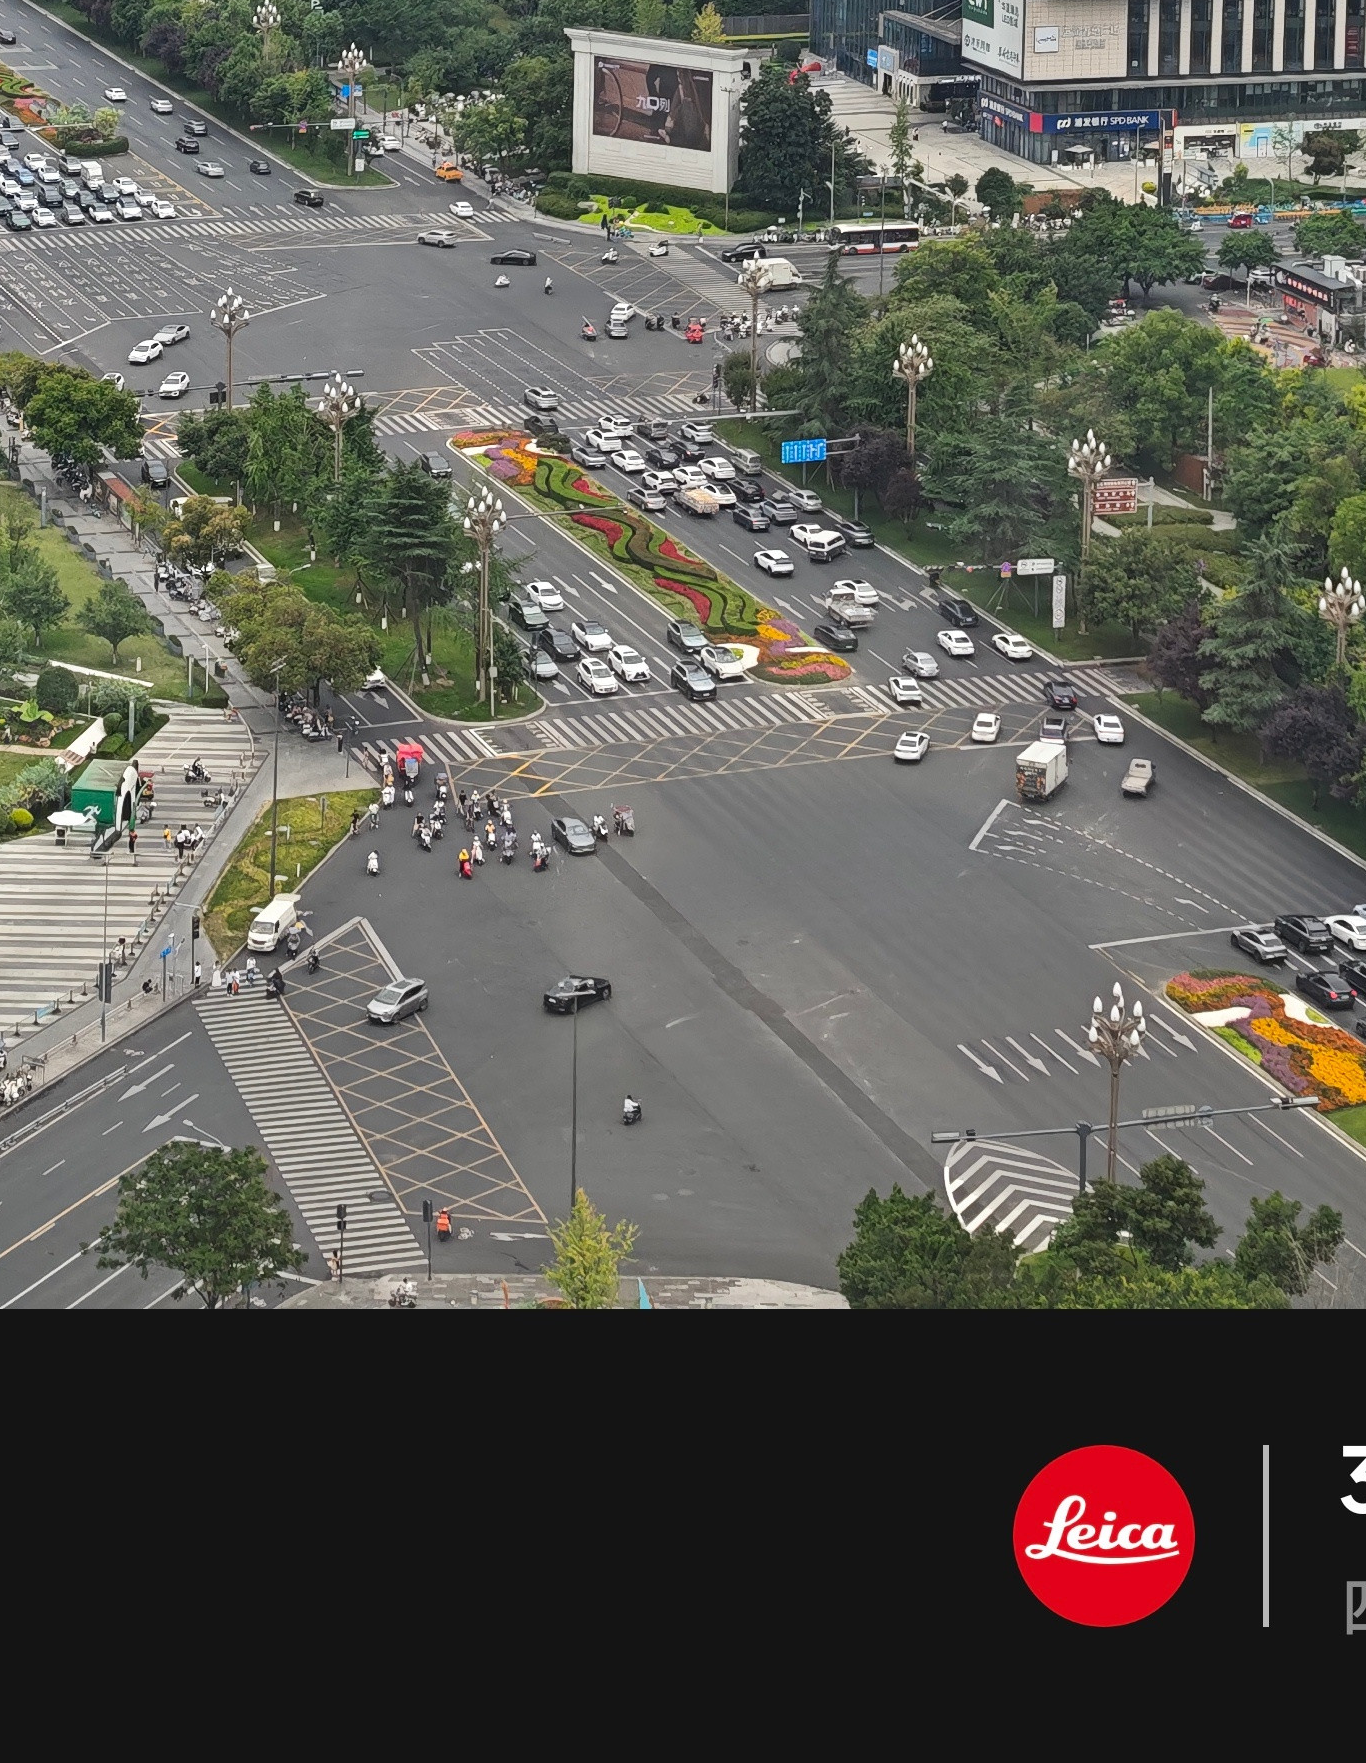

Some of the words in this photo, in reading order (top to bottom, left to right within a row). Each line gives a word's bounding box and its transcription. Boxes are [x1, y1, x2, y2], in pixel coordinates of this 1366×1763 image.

[1074, 116, 1109, 128] 浦发银行
[1110, 117, 1126, 125] SPD
[1126, 116, 1150, 125] BANK
